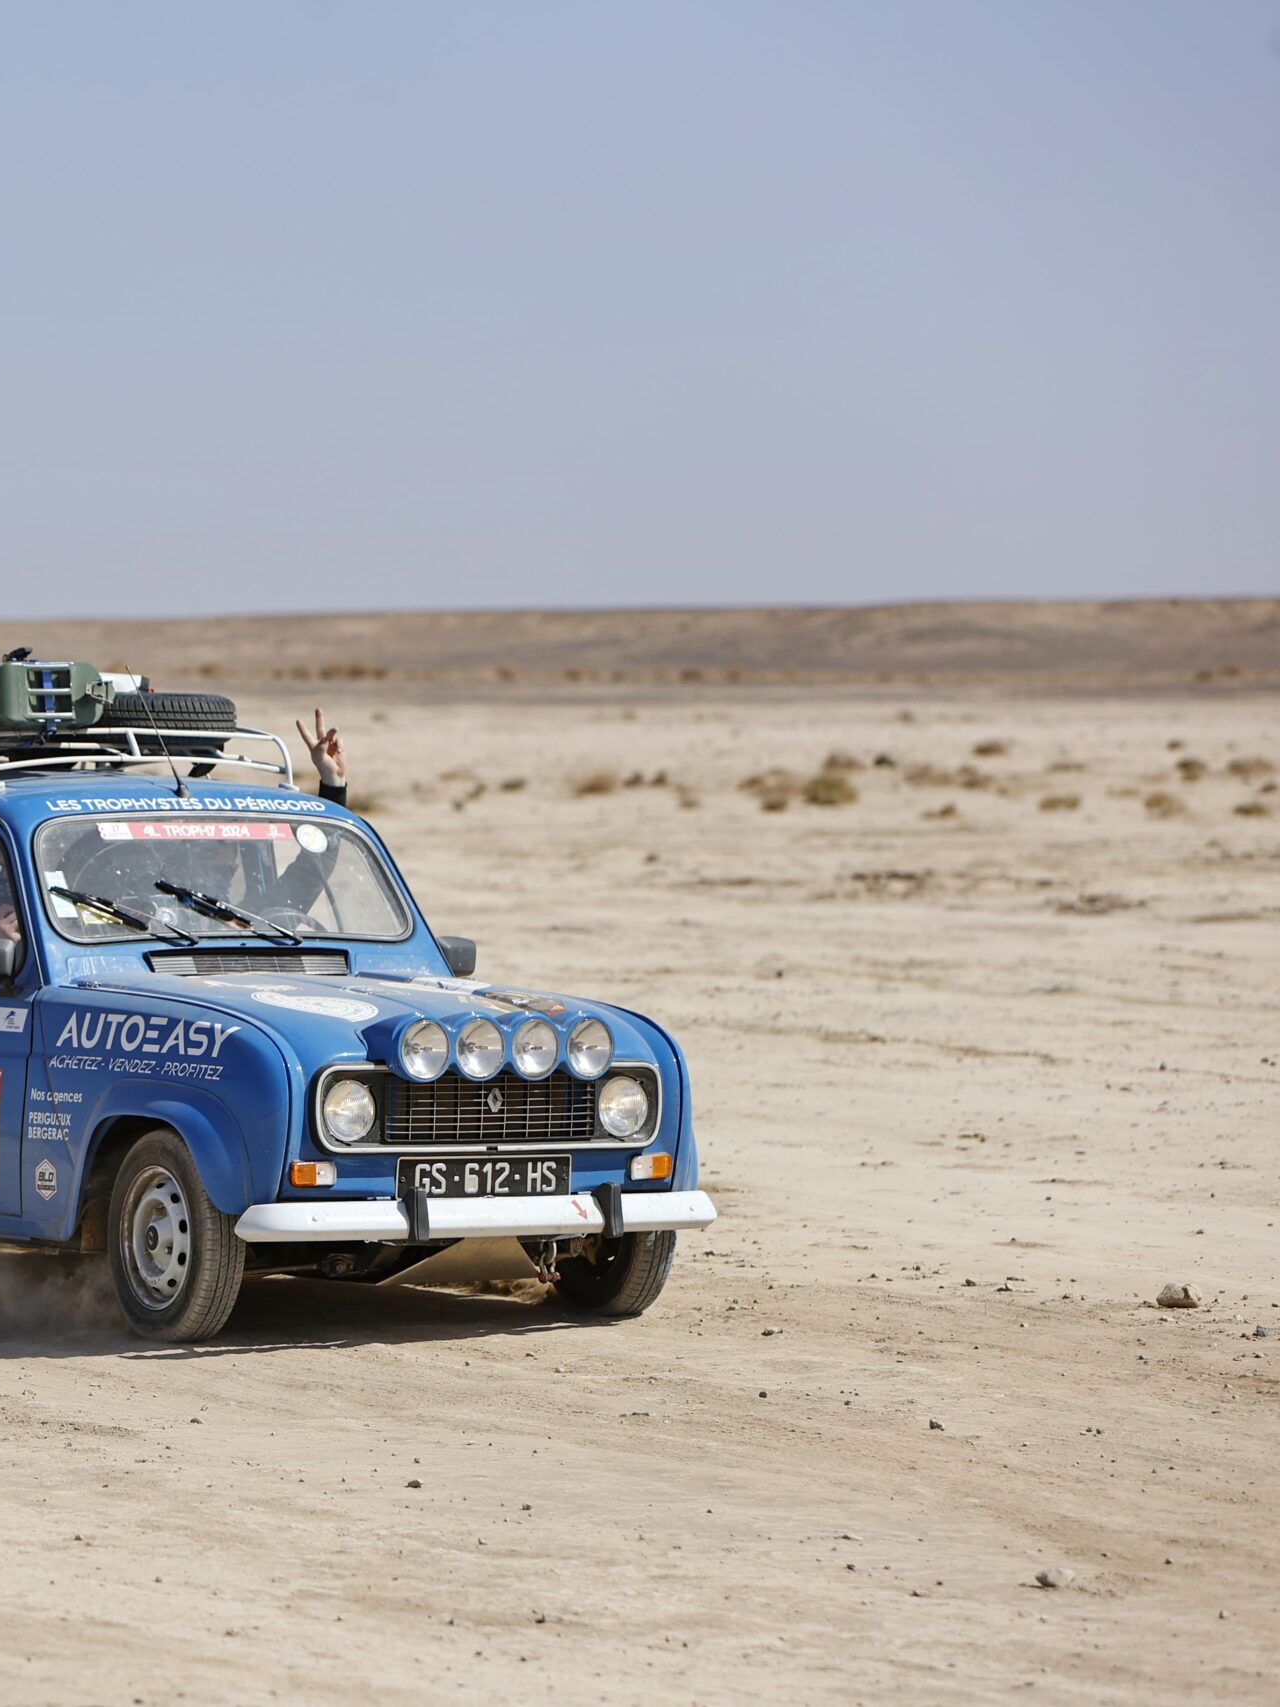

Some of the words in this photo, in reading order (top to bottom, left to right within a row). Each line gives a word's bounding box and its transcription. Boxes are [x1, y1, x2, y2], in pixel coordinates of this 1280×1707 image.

[46, 800, 82, 811] LES
[81, 798, 203, 811] TROPHYSTES
[204, 798, 232, 810] DU
[233, 796, 326, 811] PÉRIGORD
[143, 825, 161, 837] 4L
[163, 825, 216, 837] TROPHY
[219, 825, 250, 837] 2024
[56, 1010, 242, 1058] AUTOEASY
[49, 1055, 101, 1070] ACHETEZ
[108, 1058, 156, 1074] VENDEZ
[161, 1061, 223, 1080] PROFITEZ
[31, 1088, 46, 1100] Nos
[47, 1092, 83, 1104] agences
[29, 1112, 72, 1126] PERIGUEUX
[28, 1127, 69, 1141] BERGERAC
